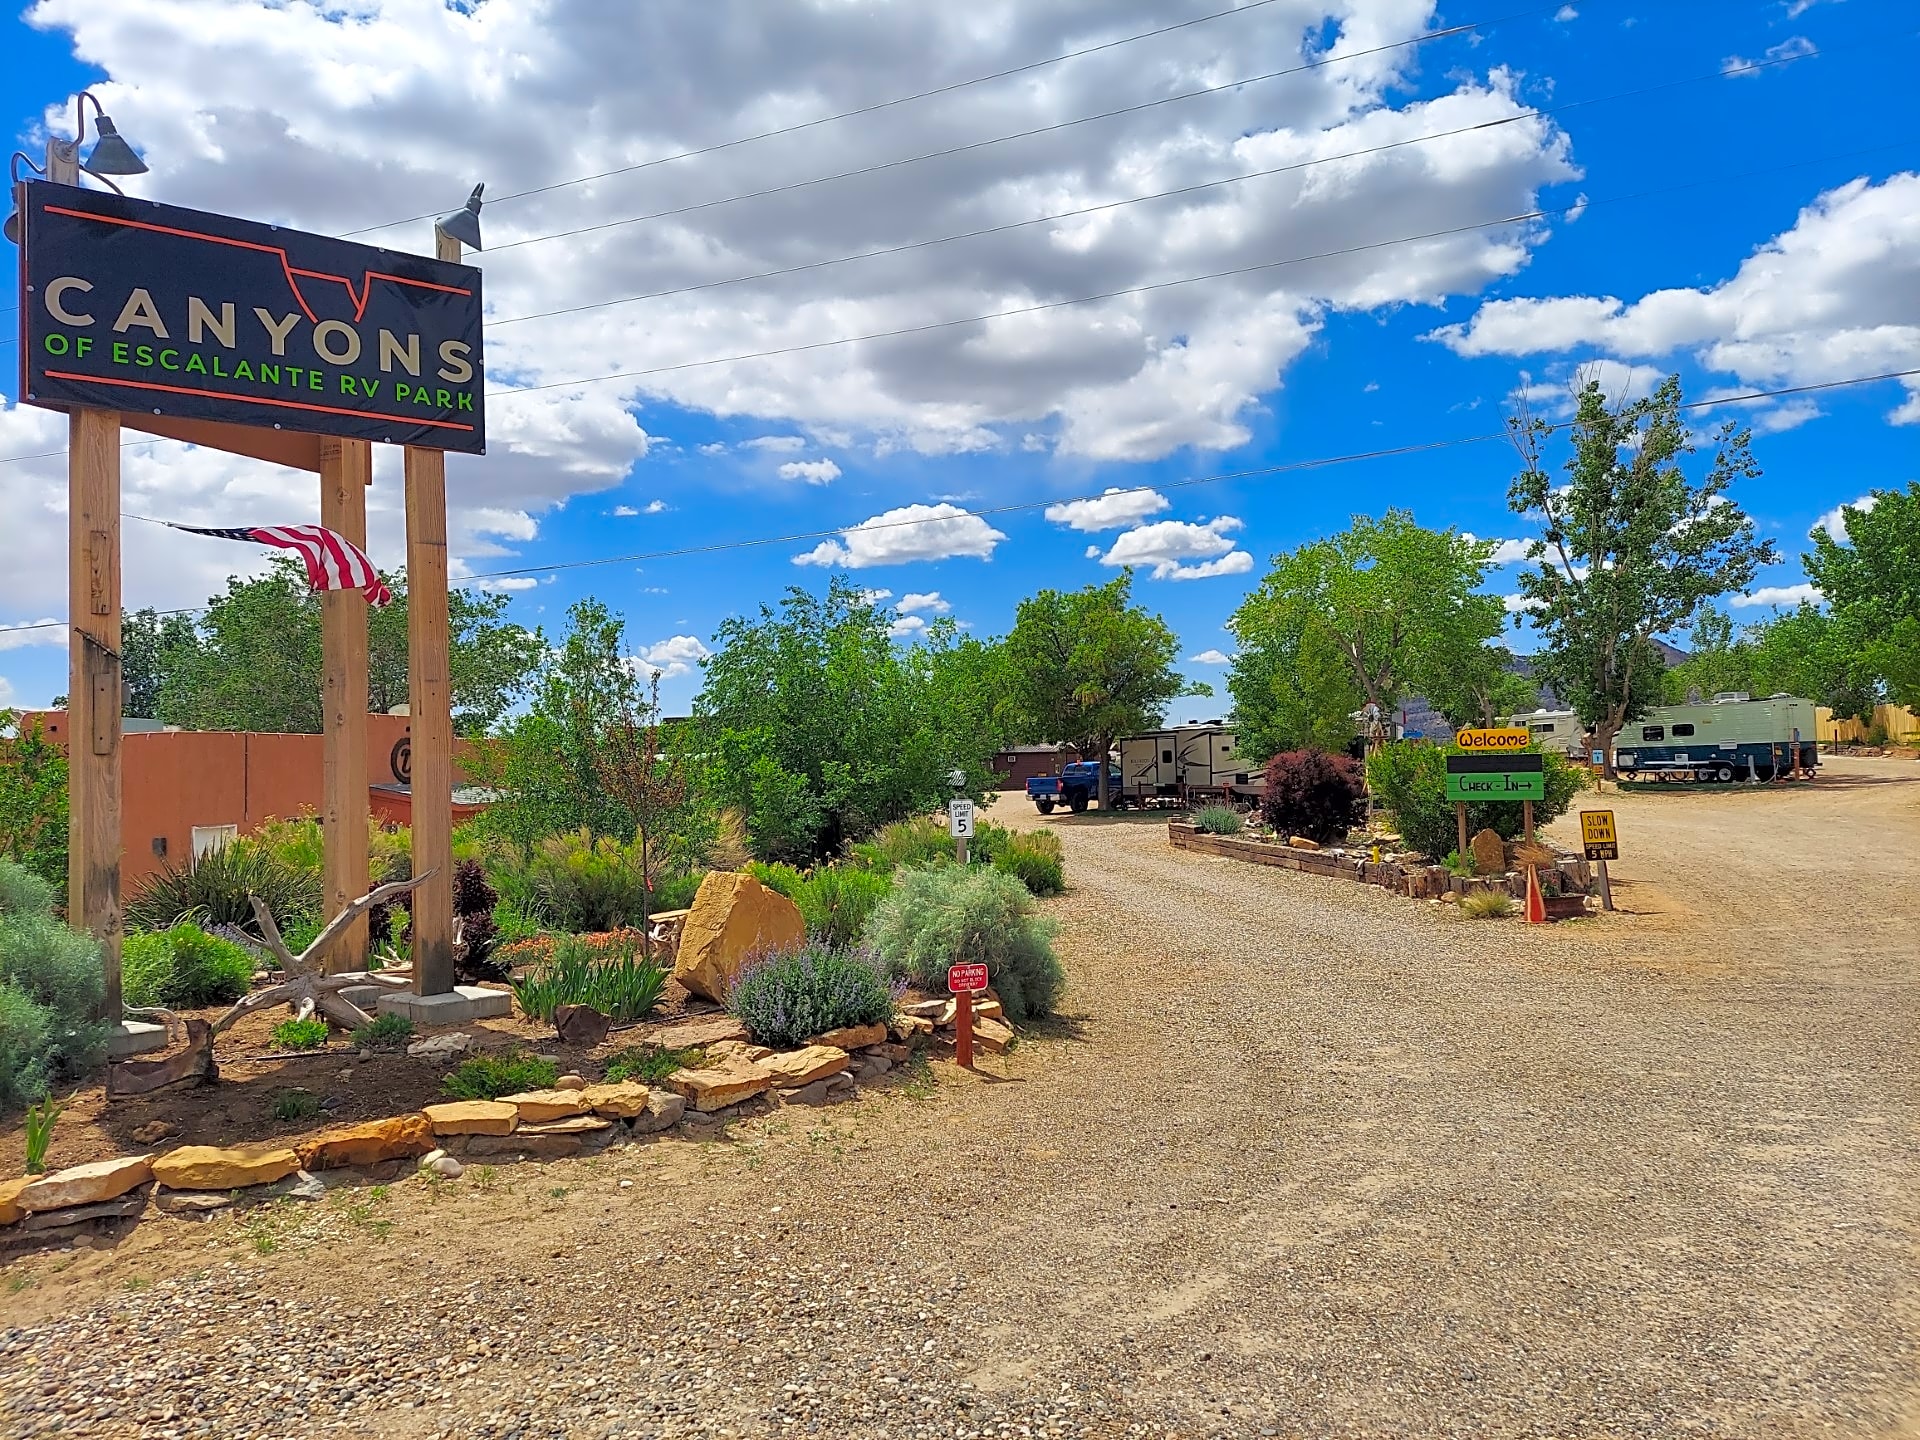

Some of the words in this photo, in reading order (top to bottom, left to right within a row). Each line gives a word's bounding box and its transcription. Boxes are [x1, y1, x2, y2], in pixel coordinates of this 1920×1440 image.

[44, 276, 474, 384] CANYONS
[44, 333, 94, 358] OF
[112, 342, 324, 391] ESCALANTE
[340, 374, 380, 398] RV
[395, 383, 474, 412] PARK
[1459, 732, 1528, 747] Welcome
[952, 803, 972, 811] SPEED
[957, 819, 967, 833] 5
[1587, 815, 1608, 826] SLOW
[1588, 828, 1611, 840] DOWN
[1591, 850, 1598, 859] 5
[952, 970, 961, 978] NO
[961, 968, 984, 977] PARKING
